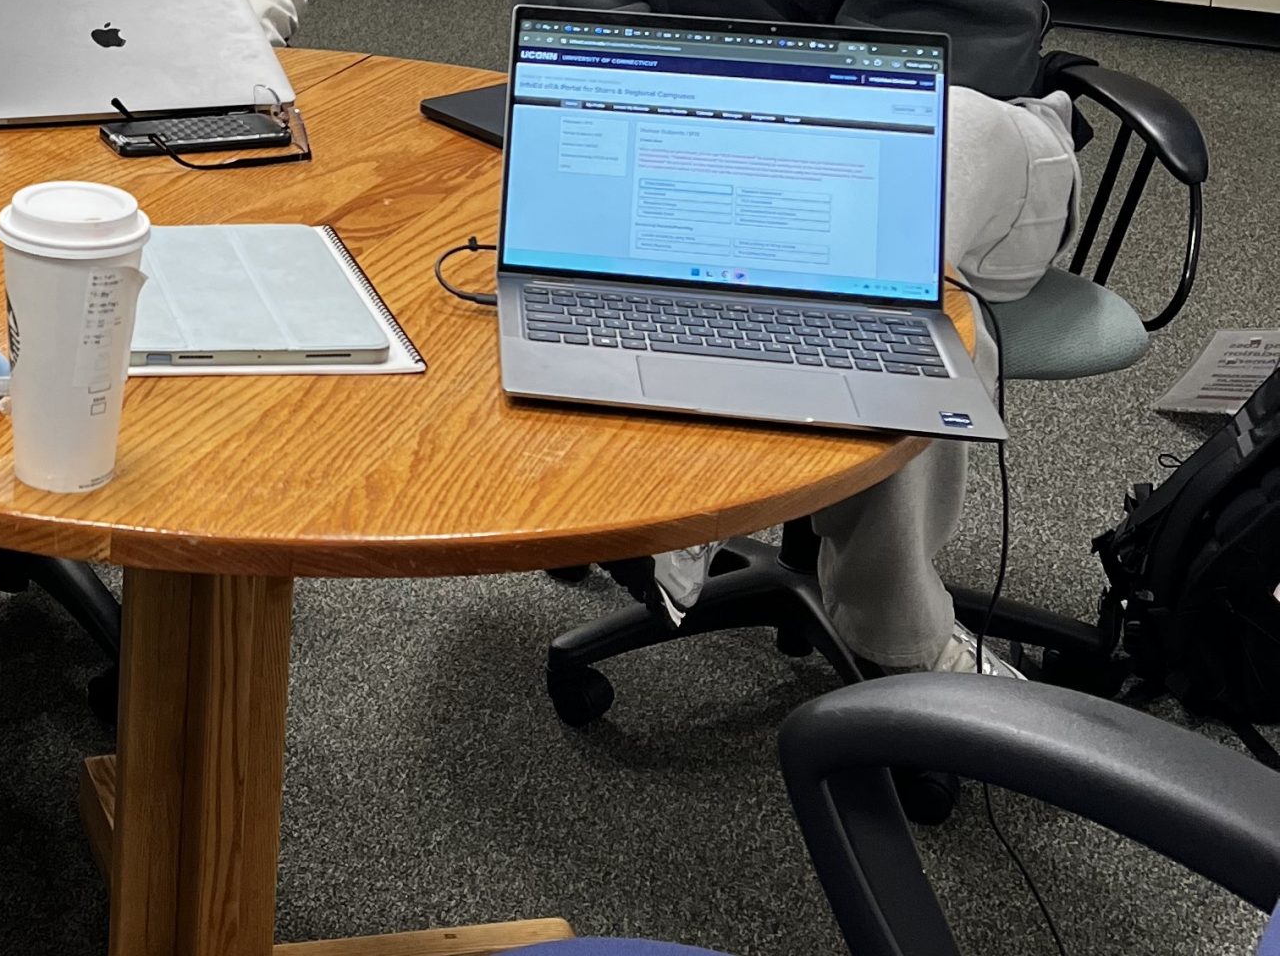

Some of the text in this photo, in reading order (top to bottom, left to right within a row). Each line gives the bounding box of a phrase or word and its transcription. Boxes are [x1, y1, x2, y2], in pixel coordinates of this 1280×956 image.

[520, 50, 558, 62] UCONN
[561, 54, 600, 64] UNIVERSITY
[611, 57, 658, 67] CONNECTICUT
